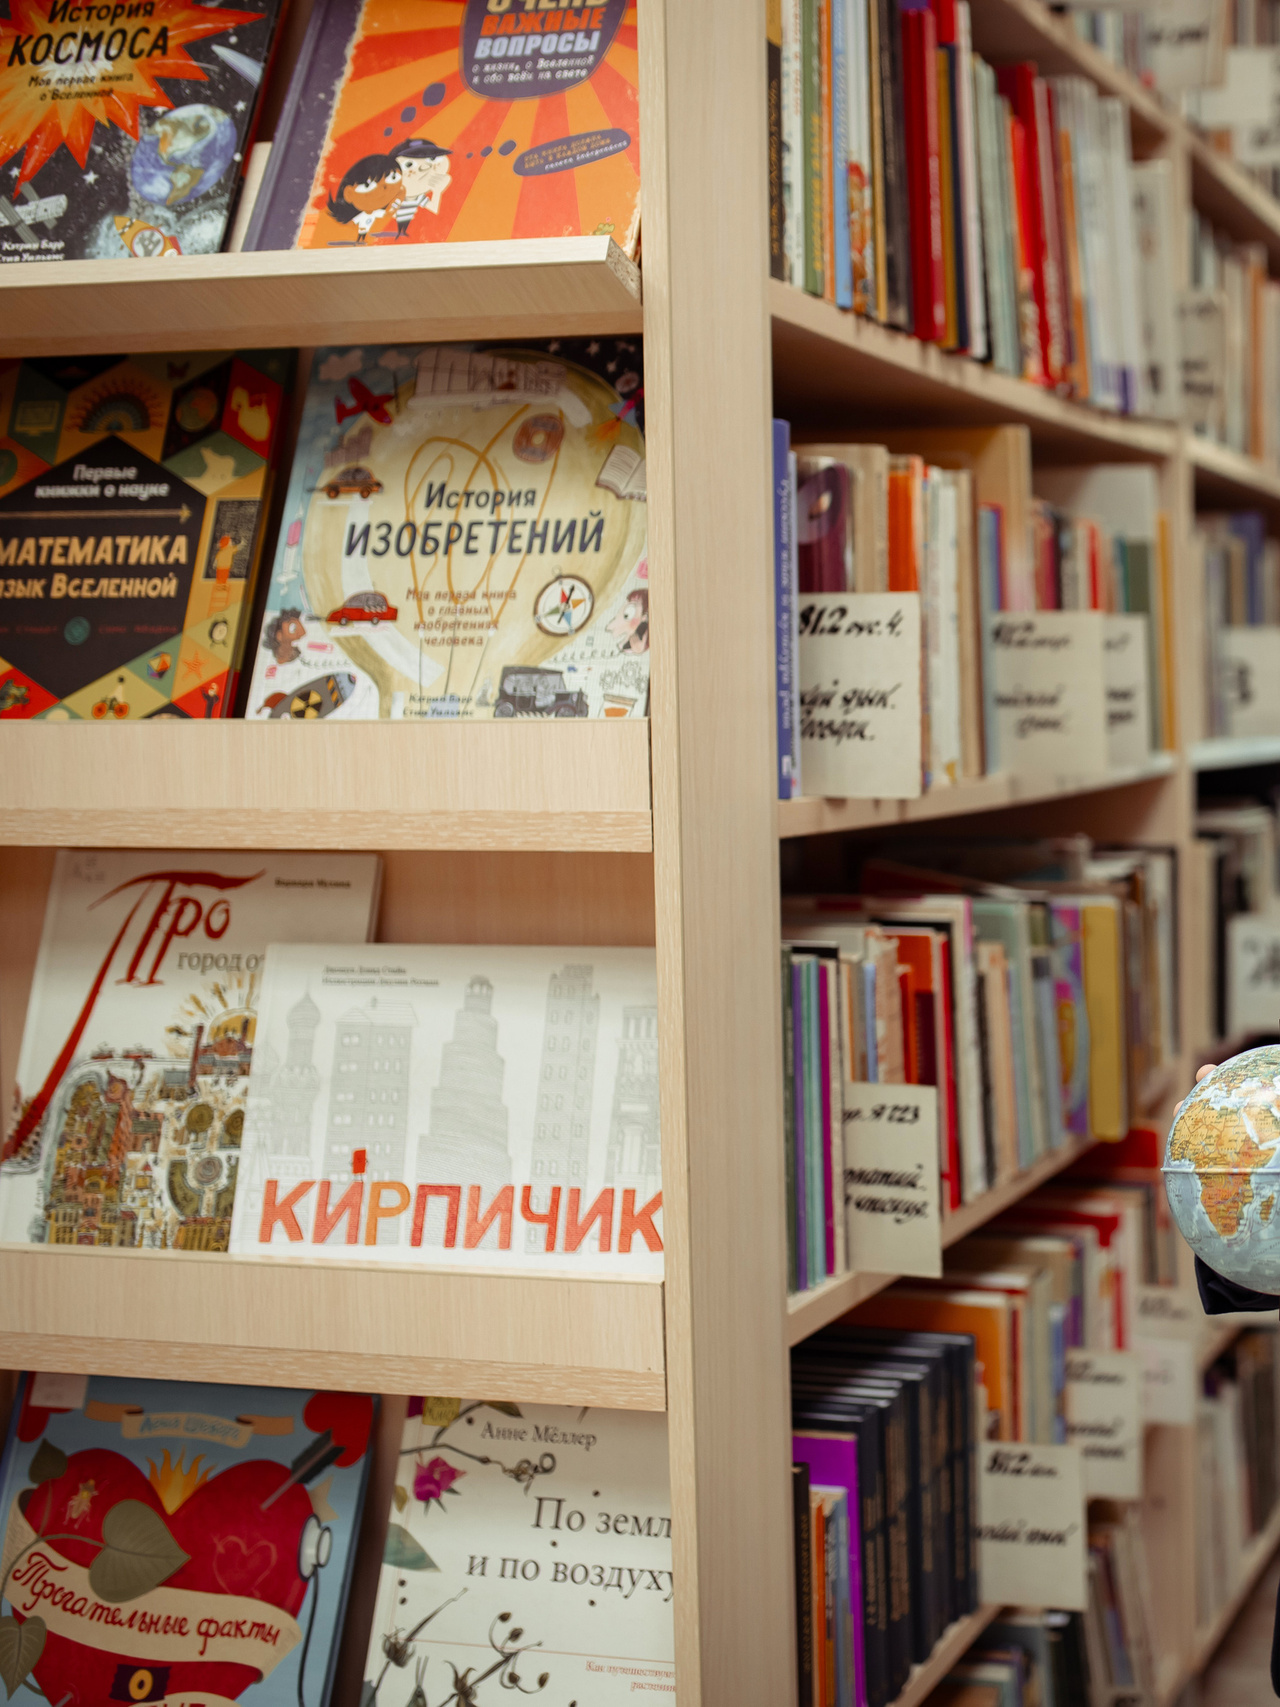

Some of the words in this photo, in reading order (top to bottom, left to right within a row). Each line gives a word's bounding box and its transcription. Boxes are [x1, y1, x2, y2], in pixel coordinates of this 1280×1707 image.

[47, 0, 155, 26] История
[480, 7, 606, 37] ВАЖНЫЕ
[7, 26, 169, 67] КОСМОСА
[473, 30, 601, 59] ВОПРОСЫ
[51, 88, 114, 100] Вселенной
[55, 75, 95, 88] первая
[100, 73, 133, 83] книга
[73, 464, 138, 482] Первые
[35, 484, 100, 498] книжки
[104, 484, 116, 496] о
[118, 482, 170, 500] науке
[425, 480, 536, 515] История
[344, 510, 605, 559] ИЗОБРЕТЕНИЙ
[0, 535, 189, 566] МАТЕМАТИКА
[435, 589, 476, 602] первая
[481, 590, 517, 600] книга
[438, 606, 489, 616] главных
[413, 617, 498, 633] изобретениях
[424, 636, 483, 647] человека
[177, 952, 241, 975] город
[258, 1178, 664, 1254] КИРПИЧИК
[480, 1421, 527, 1441] Анне
[531, 1423, 597, 1451] Мёллер
[531, 1496, 585, 1533] По
[466, 1554, 488, 1576] и
[497, 1557, 541, 1581] по
[12, 1551, 190, 1636] Трогательные
[197, 1614, 281, 1656] факты
